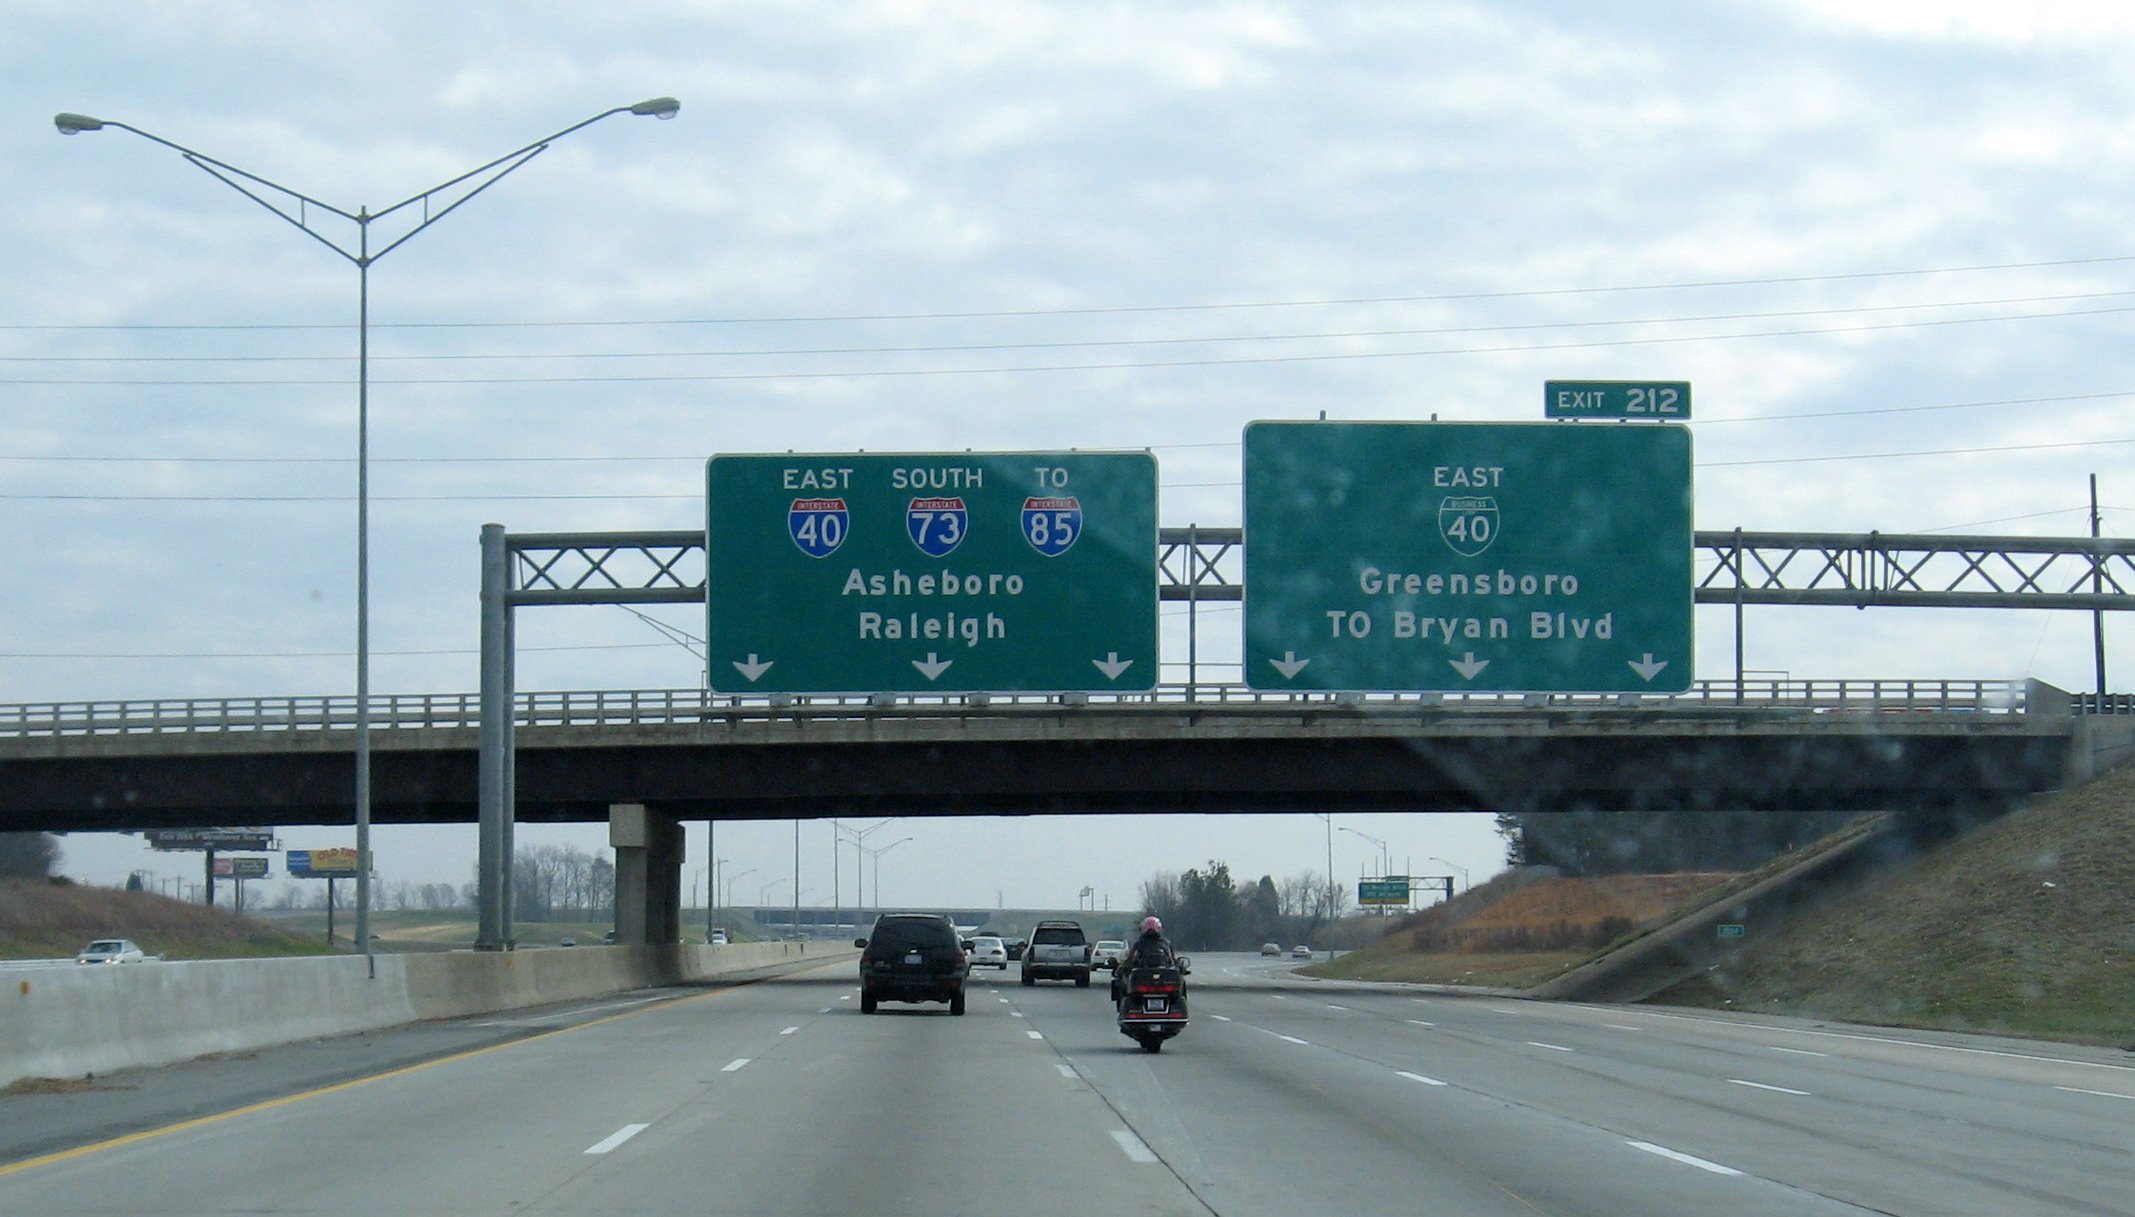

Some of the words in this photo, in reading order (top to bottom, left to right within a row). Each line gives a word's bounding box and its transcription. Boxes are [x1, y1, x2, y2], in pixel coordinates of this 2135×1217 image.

[1558, 391, 1604, 408] EXIT
[1627, 388, 1678, 412] 212
[784, 469, 853, 489] EAST
[893, 468, 982, 488] SOUTH
[1035, 468, 1068, 488] TO
[1434, 467, 1503, 487] EAST
[798, 501, 838, 509] INTERSTATE
[916, 500, 958, 509] INTERSTATE
[1031, 500, 1072, 509] INTERSTATE
[797, 514, 841, 547] 40
[912, 512, 959, 545] 73
[1031, 513, 1072, 546] 85
[1448, 516, 1489, 542] 40
[842, 569, 1023, 595] Asheboro
[1360, 568, 1579, 595] Greensboro
[860, 612, 1004, 647] Raleigh
[1327, 611, 1371, 638] TO
[1394, 610, 1507, 644] Bryan
[1531, 612, 1612, 639] Blvd
